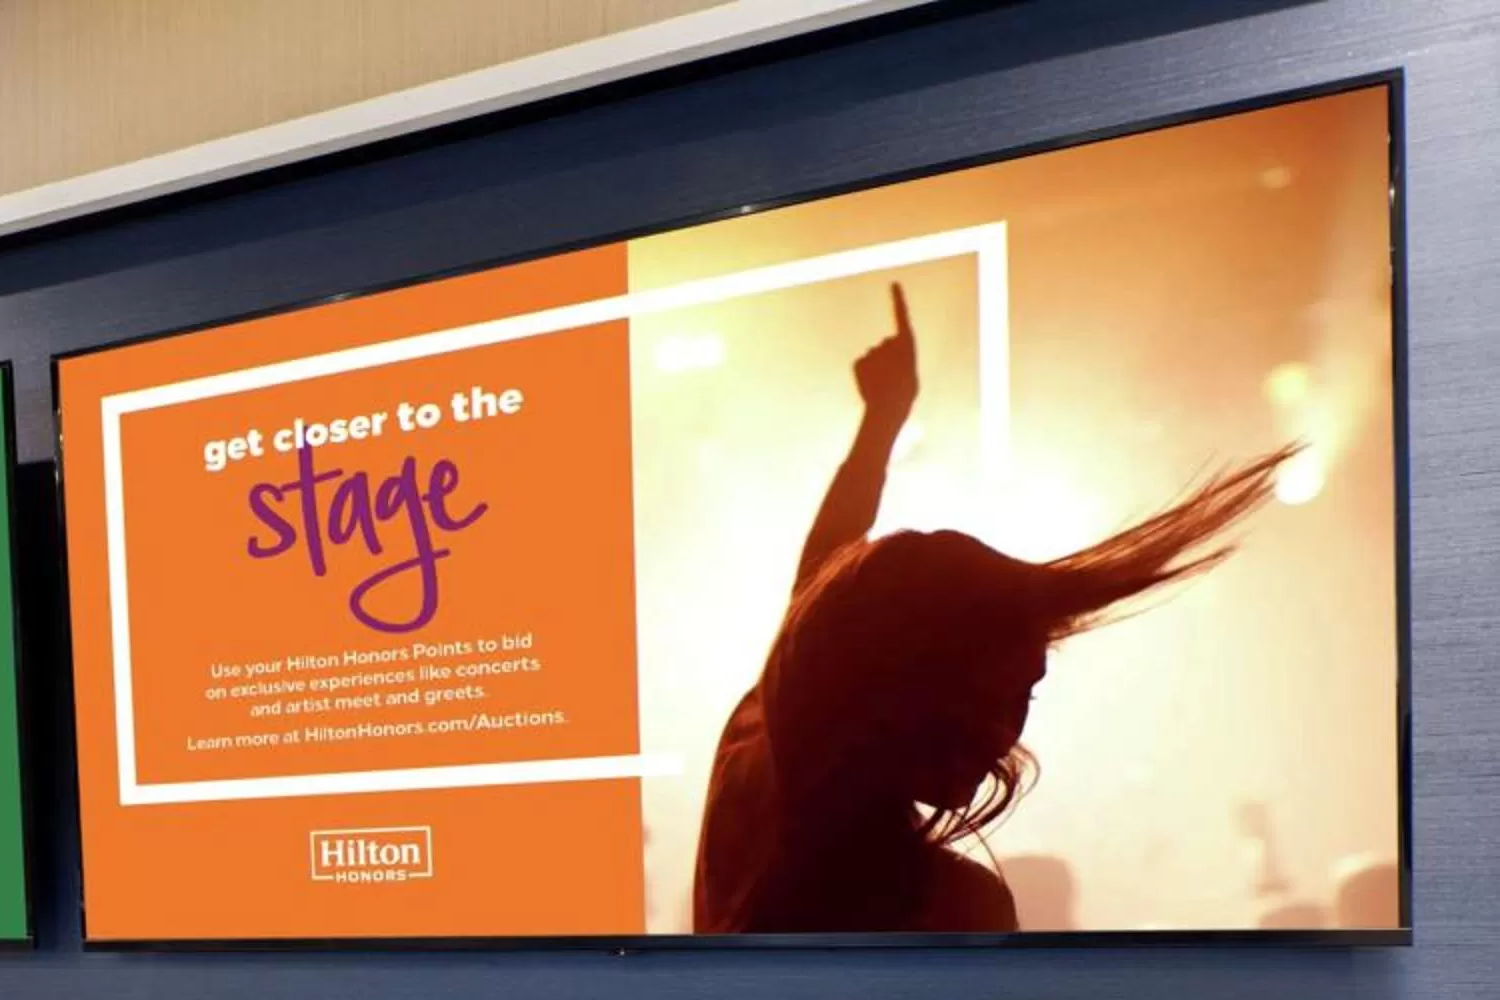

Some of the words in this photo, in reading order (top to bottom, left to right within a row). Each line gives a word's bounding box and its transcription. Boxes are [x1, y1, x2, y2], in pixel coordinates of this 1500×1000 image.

[204, 428, 264, 472] get
[273, 412, 388, 452] closer
[396, 402, 442, 431] to
[450, 386, 524, 422] the
[247, 424, 489, 633] stage
[210, 663, 241, 679] Use
[245, 661, 282, 678] your
[286, 654, 339, 671] Hilton
[343, 647, 410, 666] Honors
[412, 640, 474, 661] Points
[476, 638, 498, 652] to
[501, 633, 534, 650] bid
[205, 686, 227, 700] on
[230, 679, 306, 698] exclusive
[309, 669, 416, 692] experiences
[419, 664, 453, 681] like
[455, 656, 542, 678] concerts
[250, 700, 281, 717] and
[285, 695, 331, 714] artist
[334, 691, 383, 710] meet
[385, 688, 420, 705] and
[187, 736, 232, 751] Learn
[235, 734, 279, 748] more
[283, 730, 300, 744] at
[321, 839, 421, 867] Hilton
[336, 869, 406, 882] HONORS
